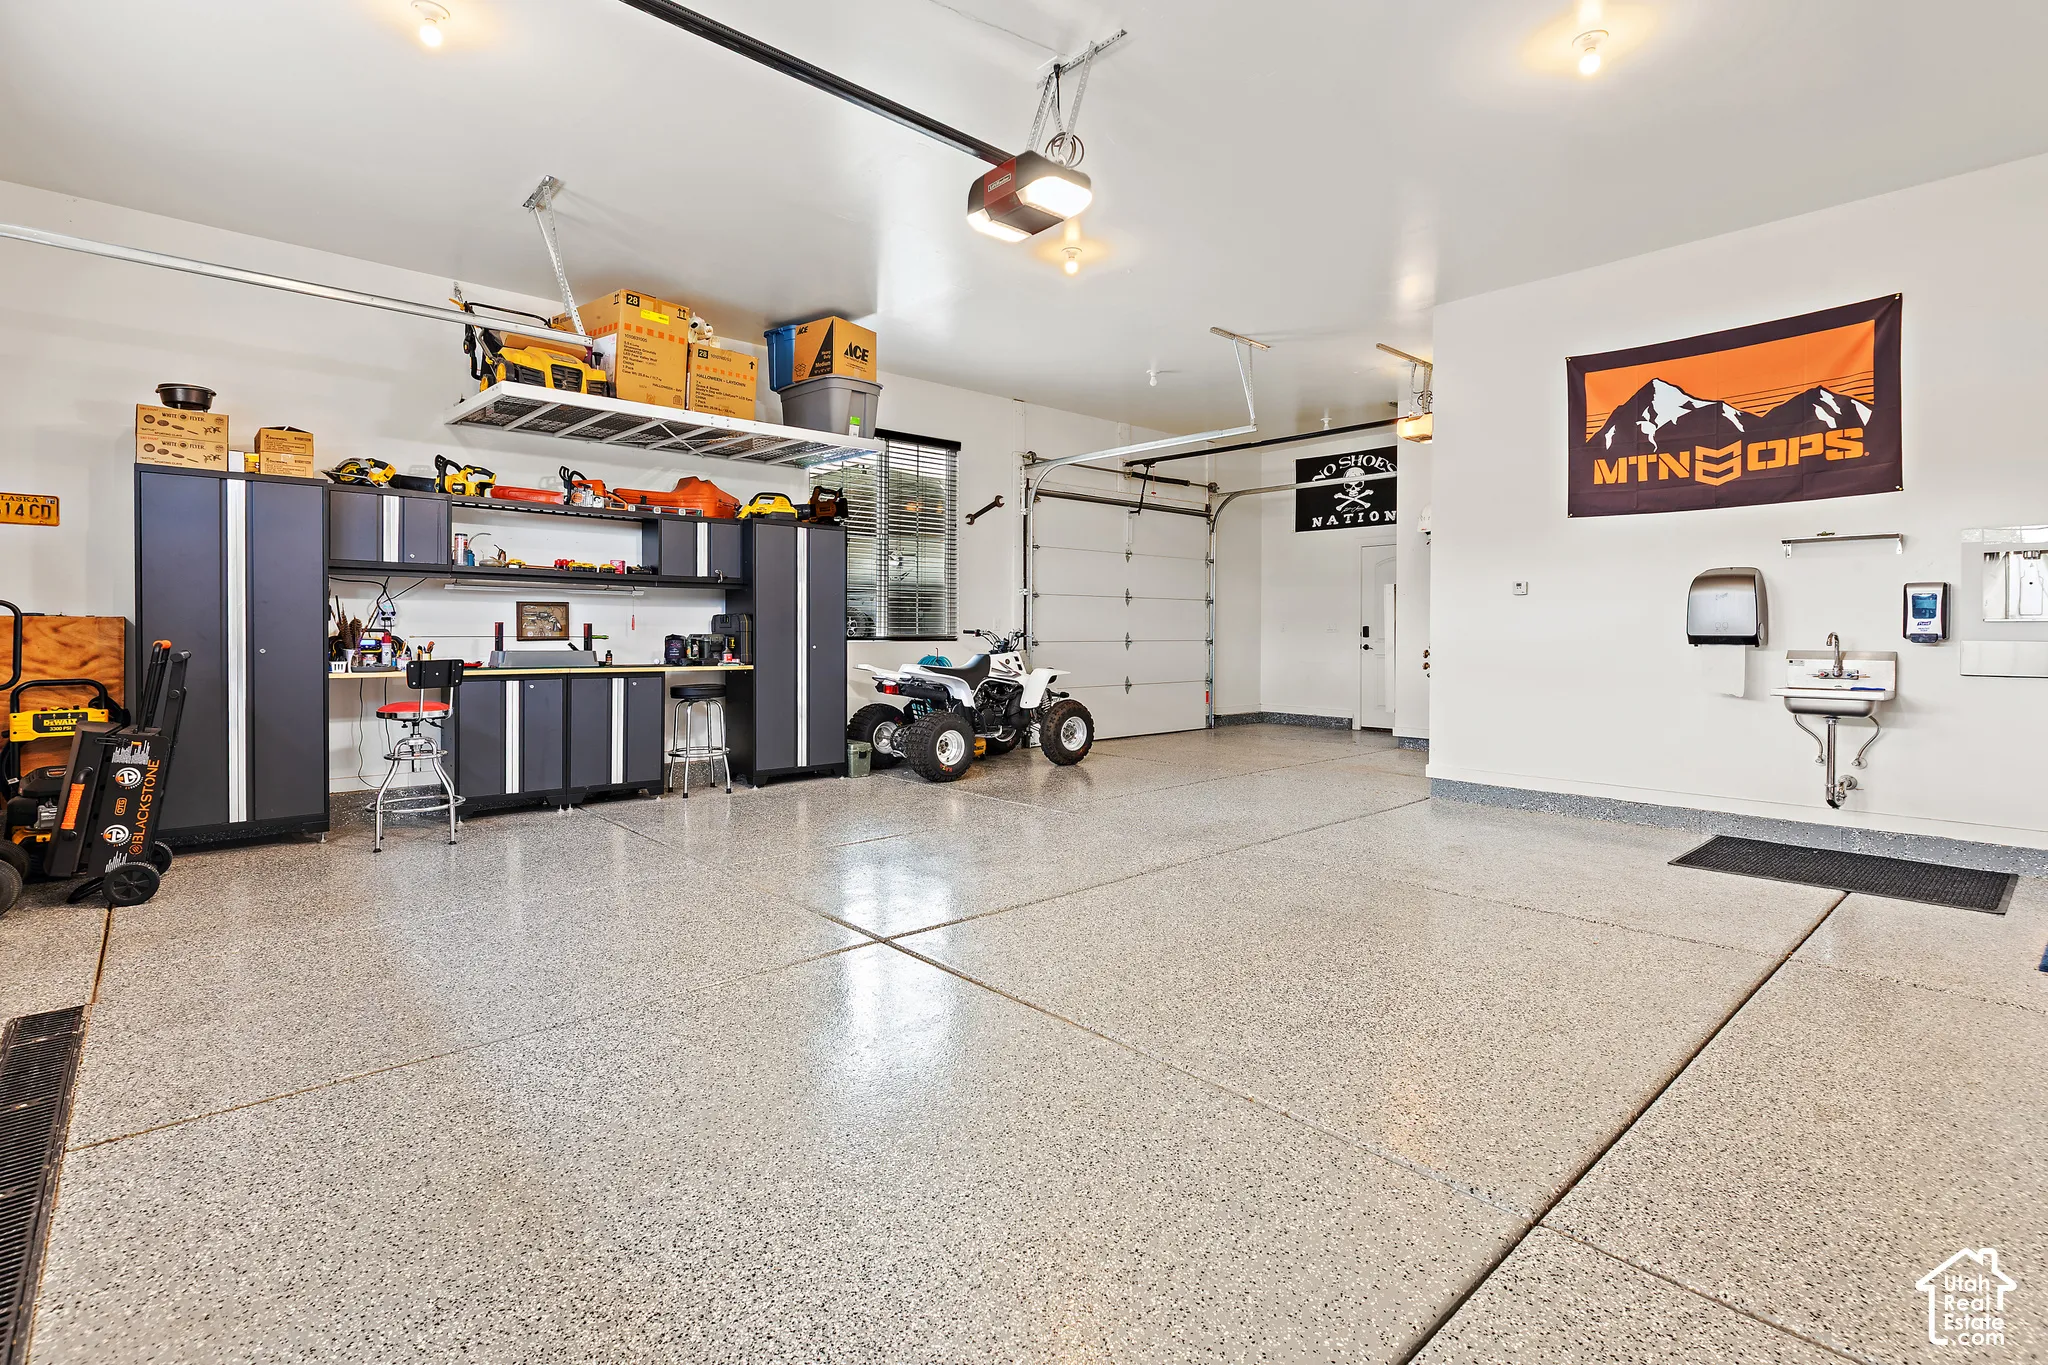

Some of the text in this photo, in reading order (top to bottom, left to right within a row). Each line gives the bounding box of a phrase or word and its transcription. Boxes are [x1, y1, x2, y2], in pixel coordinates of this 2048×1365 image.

[627, 294, 638, 305] 28
[797, 326, 808, 335] ACE
[844, 342, 869, 362] ACE
[696, 373, 722, 382] HALLOWEEN
[1594, 427, 1864, 485] MTN OPS
[0, 495, 39, 503] LASKA
[0, 502, 51, 520] 14CD
[1312, 510, 1396, 528] NATION
[116, 799, 125, 814] OTG
[132, 759, 160, 844] BLACKSTONE
